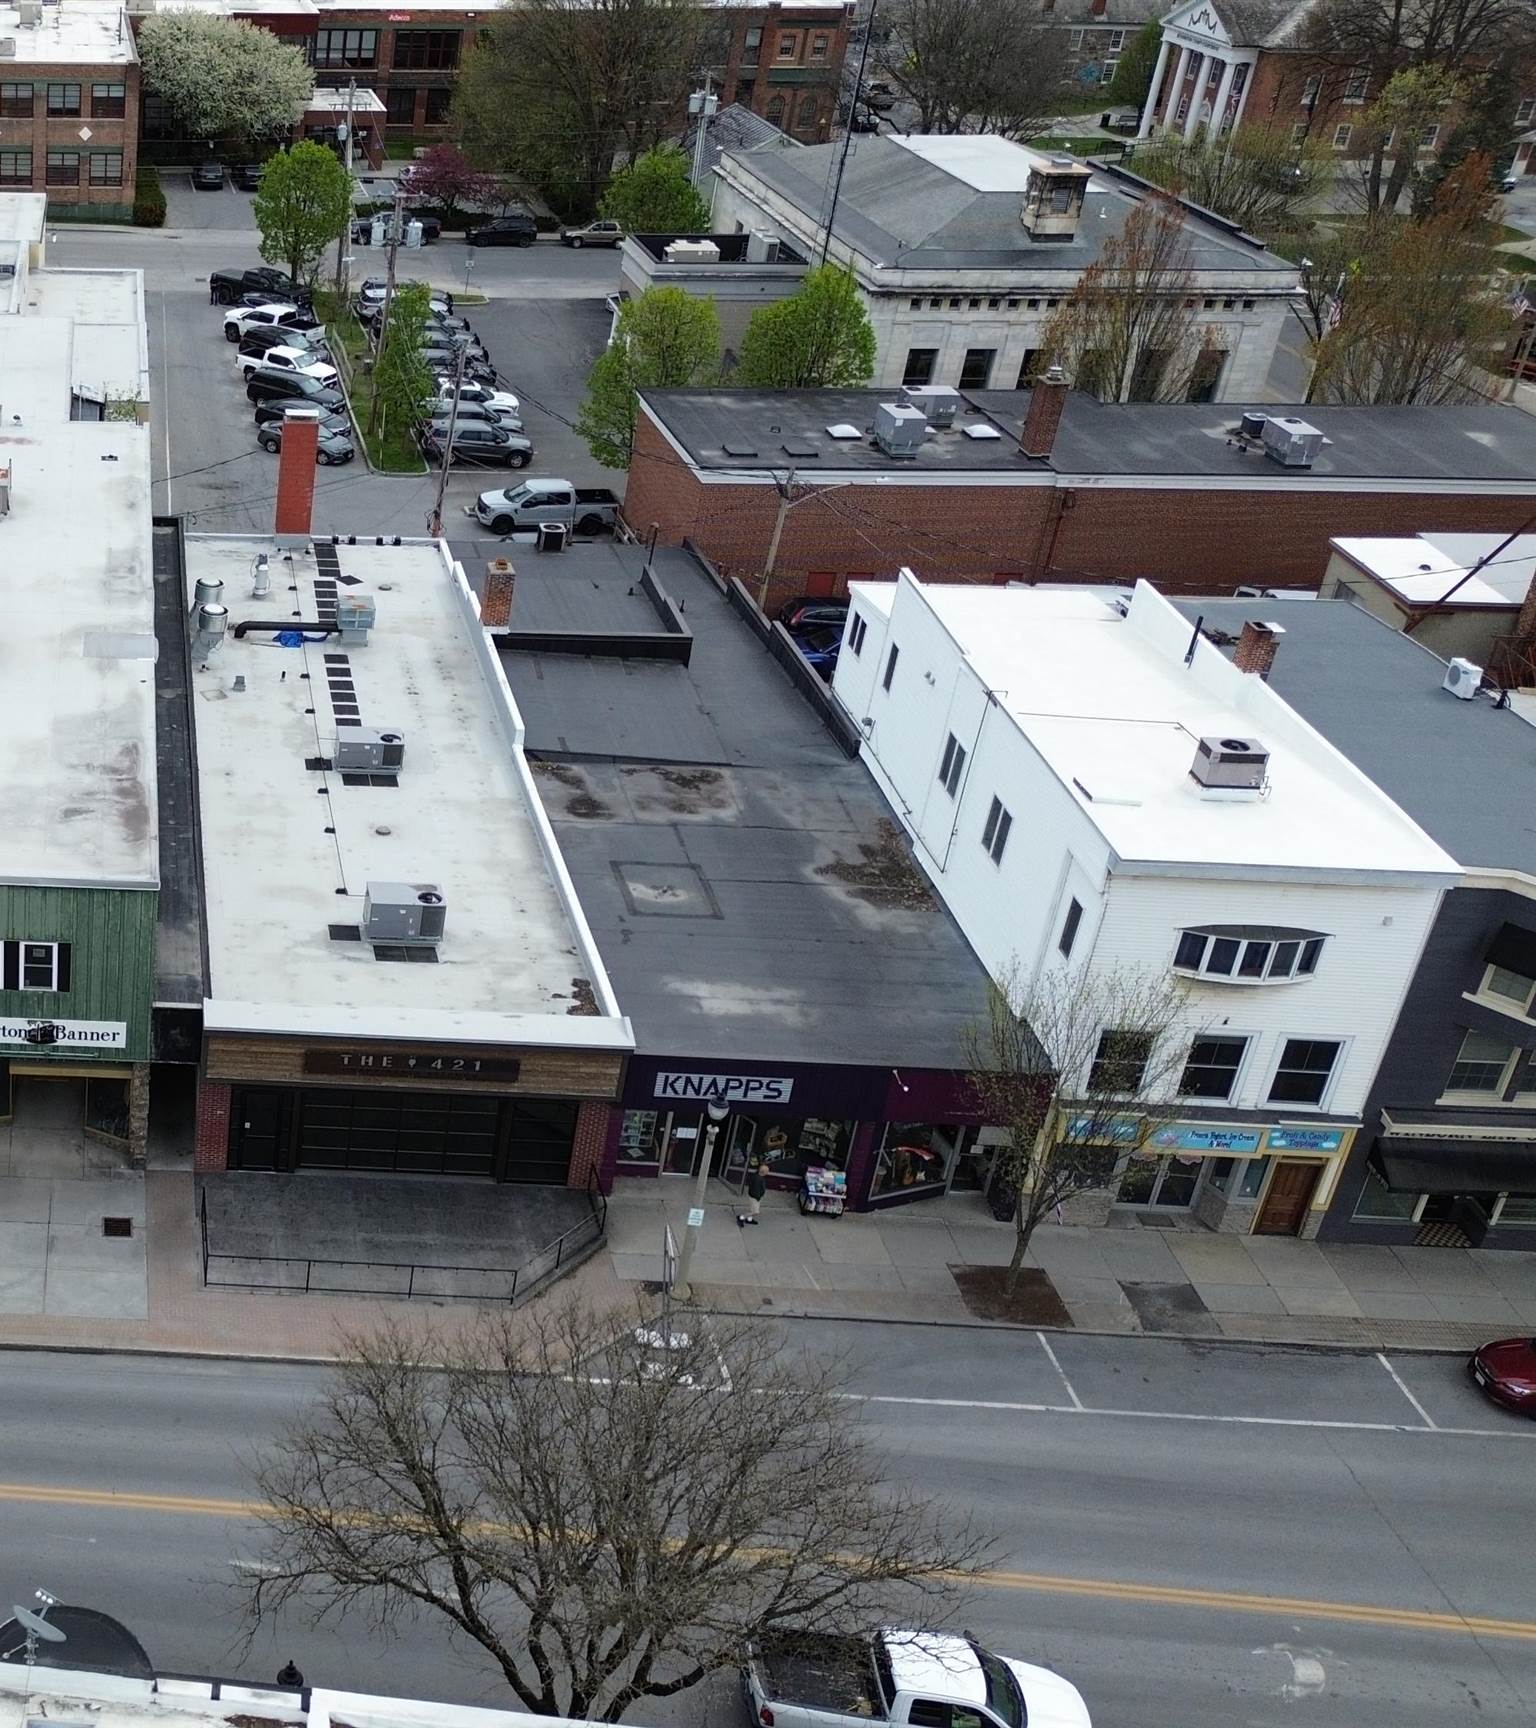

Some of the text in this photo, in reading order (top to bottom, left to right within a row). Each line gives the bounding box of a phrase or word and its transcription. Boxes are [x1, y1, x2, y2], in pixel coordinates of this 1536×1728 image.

[53, 1024, 120, 1042] Banner
[340, 1054, 481, 1072] THE 421
[662, 1074, 784, 1100] KNAPPS
